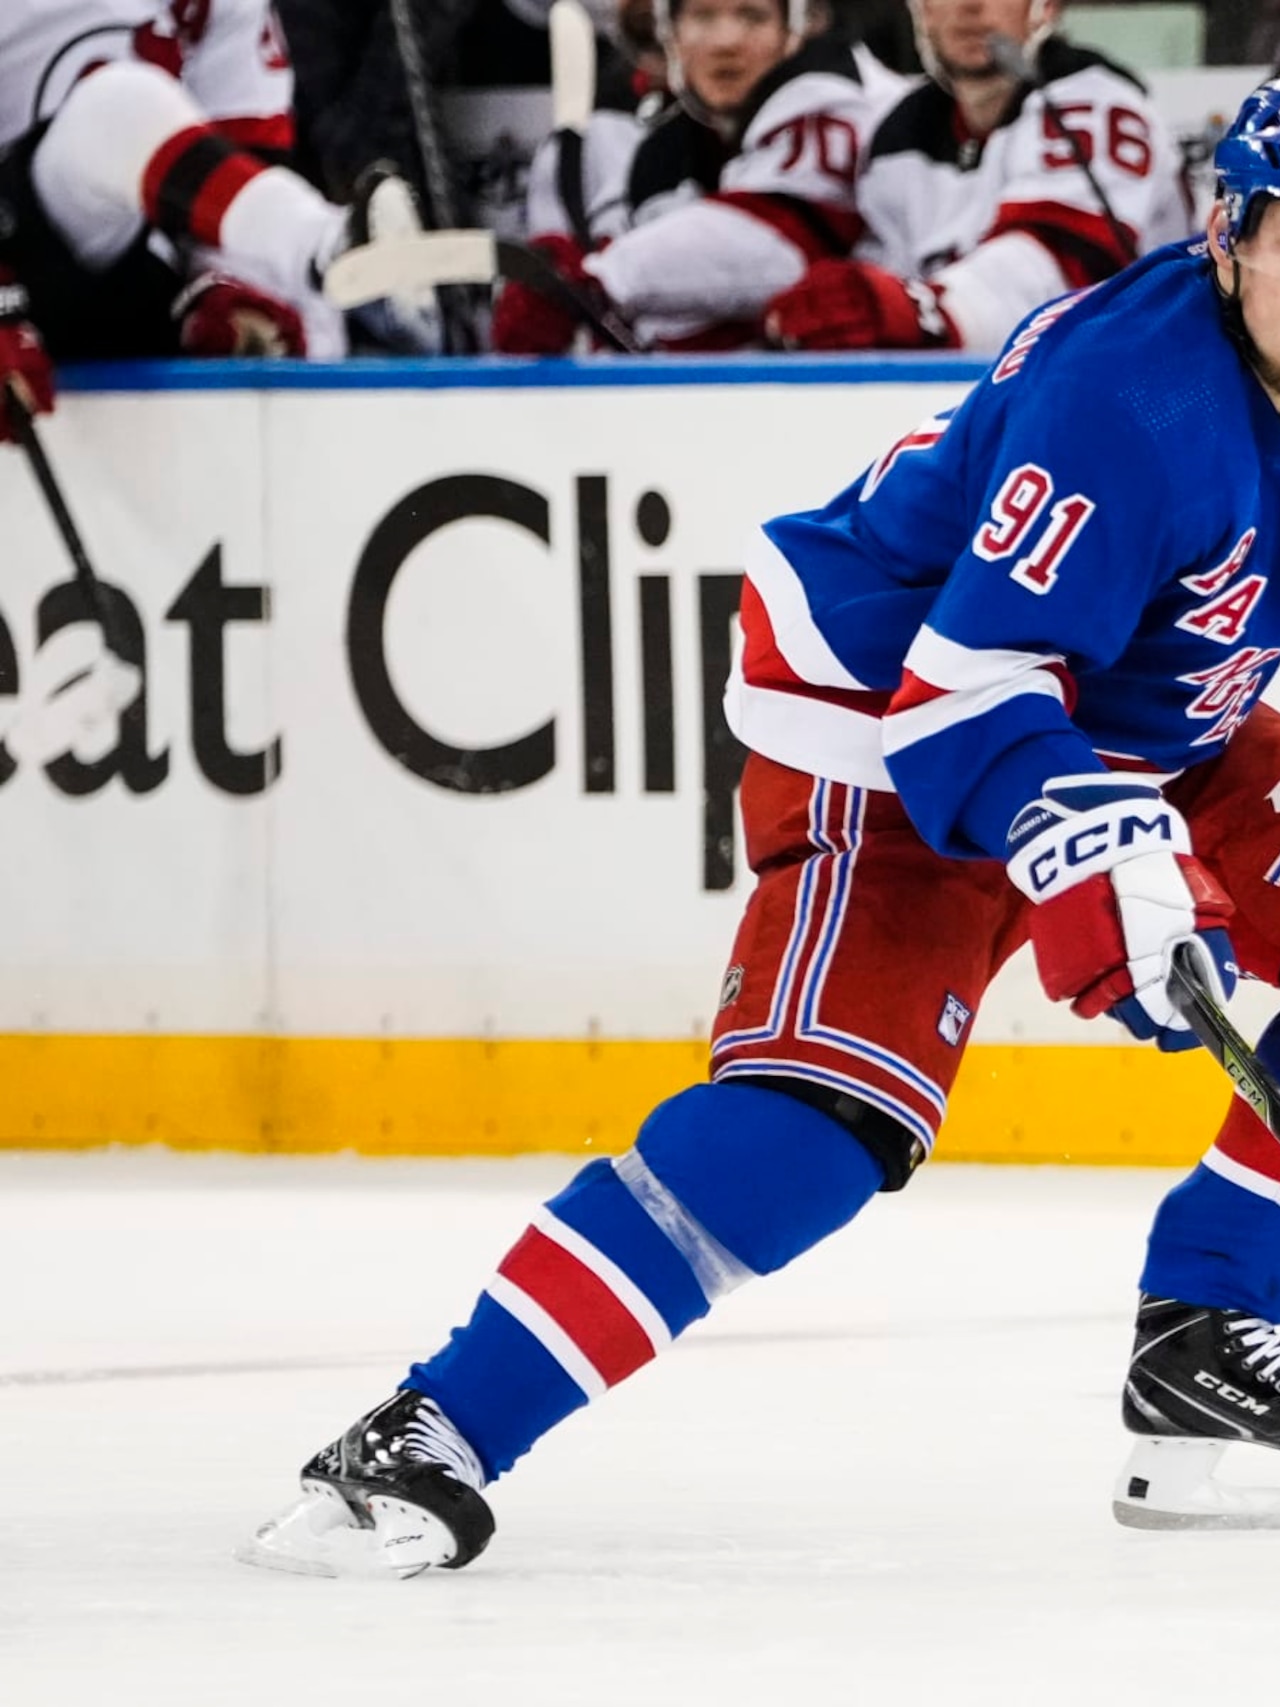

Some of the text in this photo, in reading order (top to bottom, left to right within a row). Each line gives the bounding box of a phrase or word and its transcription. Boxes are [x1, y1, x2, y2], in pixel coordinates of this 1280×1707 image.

[757, 112, 859, 184] 70
[1042, 103, 1152, 179] 56
[972, 462, 1096, 595] 91
[0, 538, 283, 794] at
[1028, 813, 1173, 893] CCM
[1226, 1061, 1263, 1107] CCM
[1193, 1368, 1271, 1417] CCM
